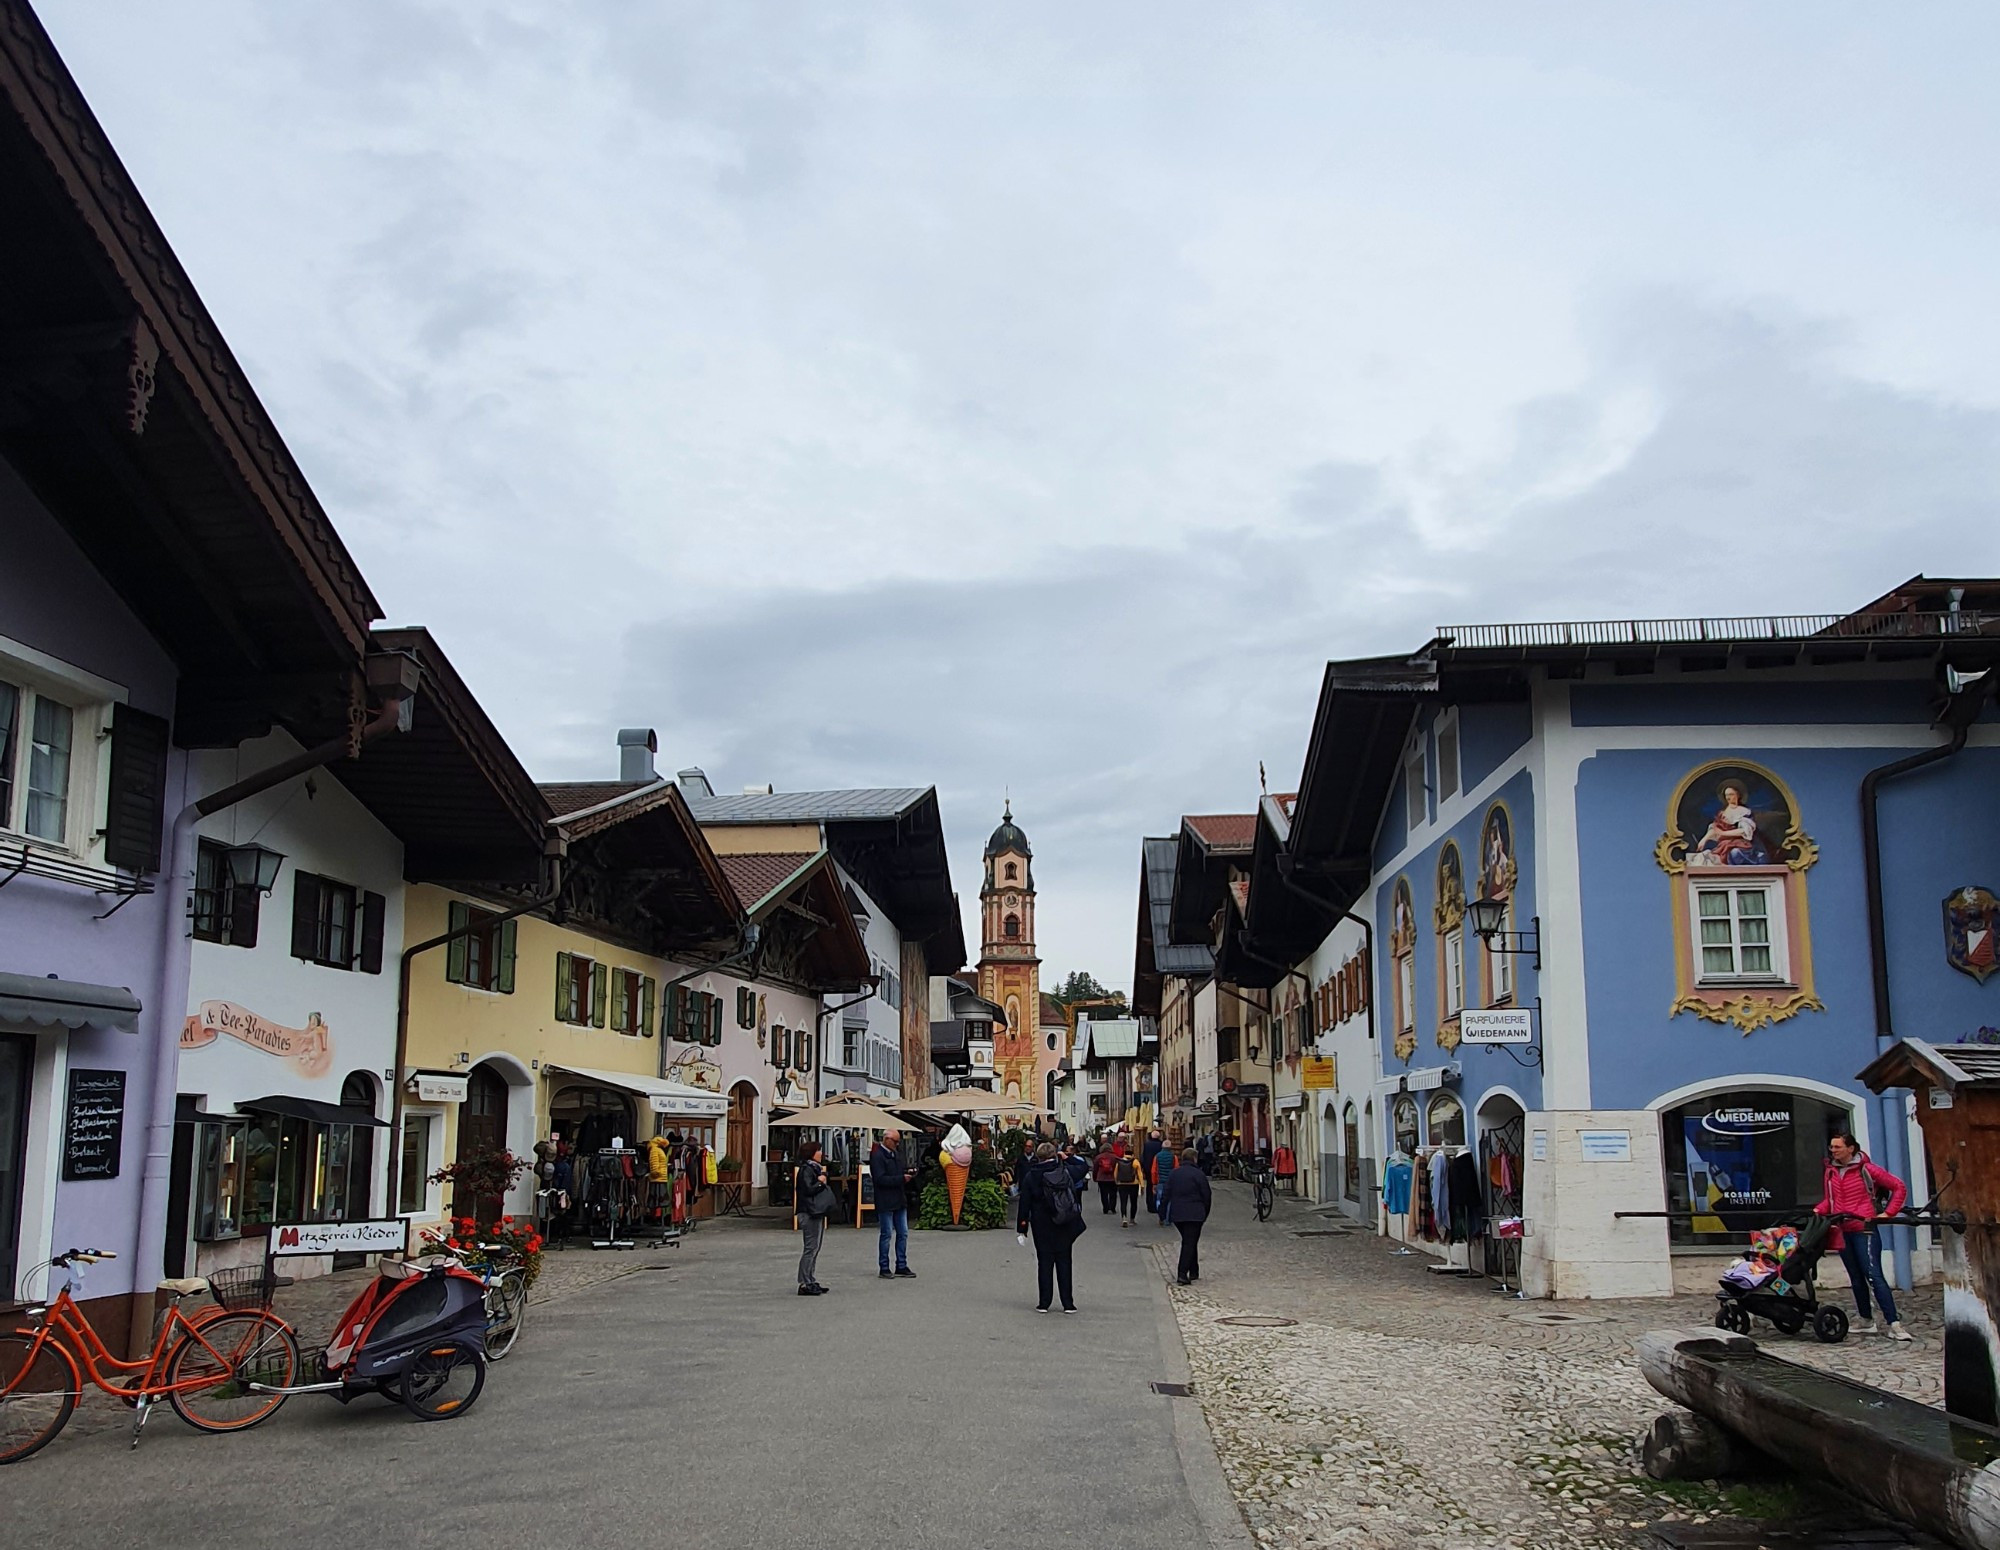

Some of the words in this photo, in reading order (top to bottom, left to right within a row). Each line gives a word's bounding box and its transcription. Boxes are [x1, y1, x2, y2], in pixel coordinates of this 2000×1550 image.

[1465, 1014, 1526, 1024] PARFÜMERIE
[206, 1009, 215, 1024] &
[220, 1003, 292, 1051] Tee-Paradies
[1465, 1026, 1528, 1037] WIEDEMANN
[1714, 1108, 1790, 1122] WIEDEMANN
[279, 1227, 350, 1250] Metzgerei
[352, 1225, 399, 1241] Rieder
